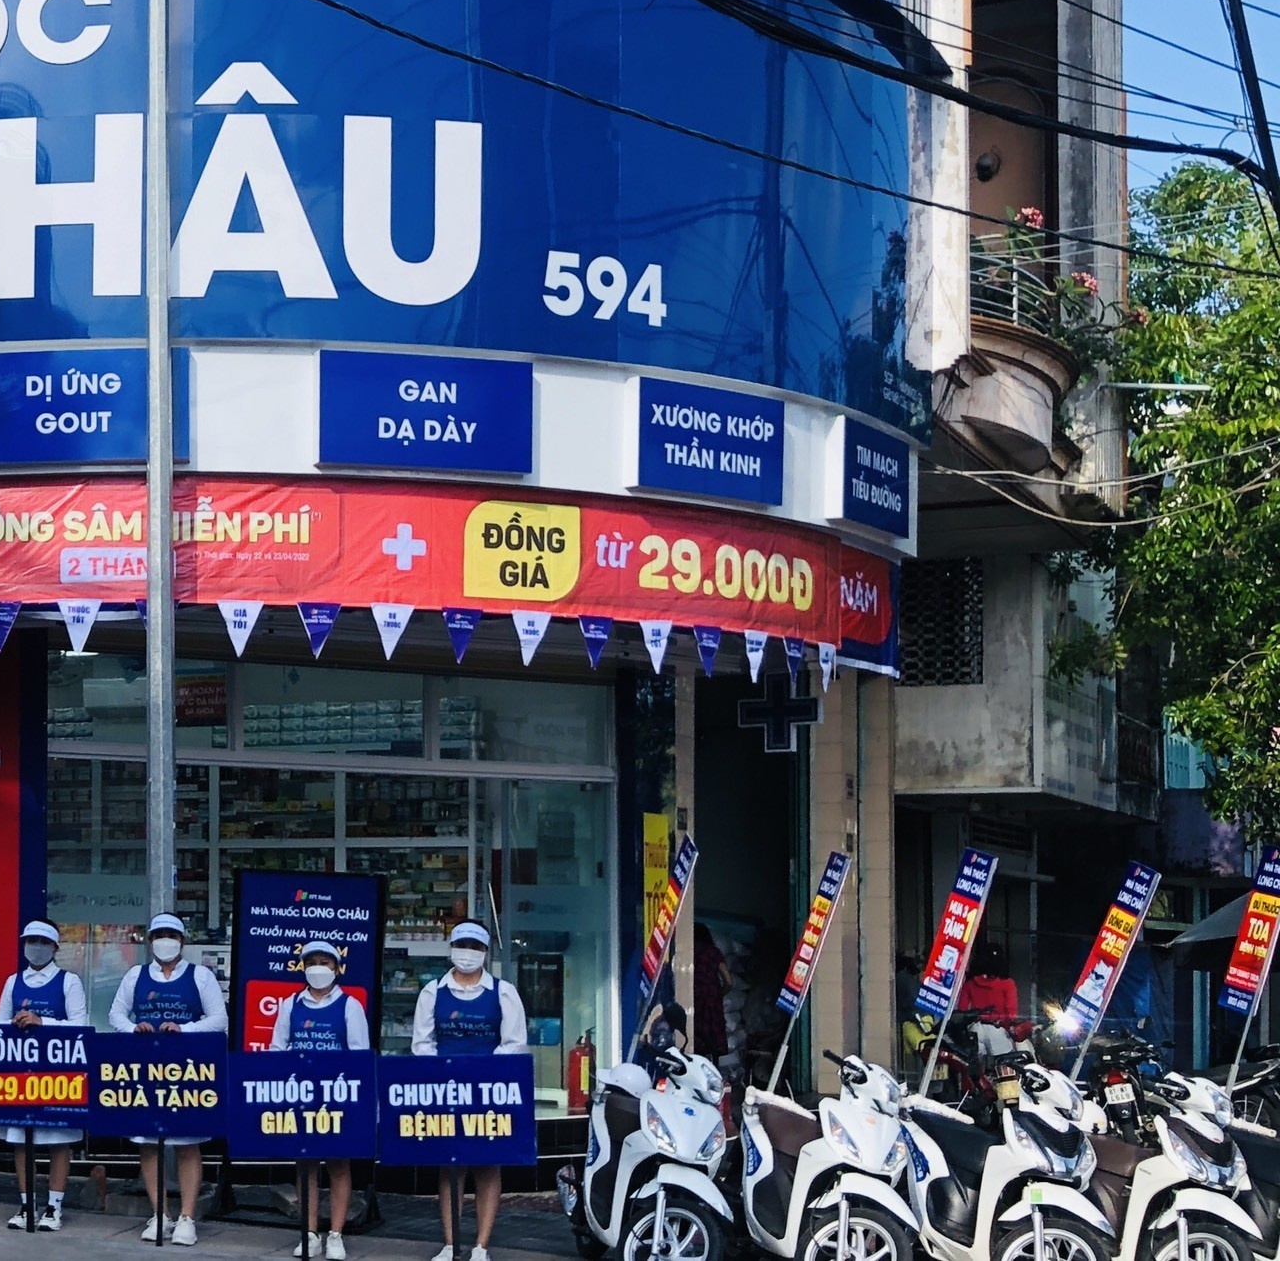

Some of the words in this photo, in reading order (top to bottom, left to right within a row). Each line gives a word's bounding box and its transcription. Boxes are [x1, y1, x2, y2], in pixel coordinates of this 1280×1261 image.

[542, 250, 668, 327] 594
[25, 375, 53, 402] DỊ
[60, 367, 122, 396] ỨNG
[398, 378, 458, 404] GAN
[35, 410, 112, 435] GOUT
[377, 416, 416, 446] DẠ
[424, 413, 477, 445] DÀY
[651, 402, 722, 434] XƯƠNG
[726, 413, 775, 443] KHỚP
[664, 436, 715, 470] THẦN
[719, 450, 761, 478] KINH
[856, 443, 871, 468] TIM
[872, 449, 899, 480] MẠCH
[851, 468, 870, 502] TIỂU
[870, 474, 902, 513] ĐƯỜNG
[63, 502, 143, 542] SÂM
[249, 504, 311, 544] PHÍ
[482, 512, 566, 554] ĐỒNG
[67, 557, 82, 577] 2
[87, 551, 148, 577] THÁN
[499, 554, 550, 589] GIÁ
[595, 531, 635, 570] từ
[638, 535, 814, 612] 29.000Đ
[840, 570, 879, 617] NĂM
[251, 905, 269, 915] NHÀ
[271, 905, 300, 917] THUỐC
[302, 907, 335, 919] LONG
[337, 907, 370, 921] CHÂU
[250, 925, 282, 937] CHUỖI
[284, 928, 307, 939] NHÀ
[308, 929, 345, 940] THUỐC
[346, 932, 368, 942] LỚN
[1247, 917, 1269, 942] TOA
[267, 945, 291, 954] HƠN
[269, 962, 284, 973] TẠI
[47, 1034, 88, 1064] GIÁ
[100, 1063, 141, 1087] BẠT
[148, 1058, 216, 1082] NGÀN
[243, 1073, 315, 1103] THUỐC
[320, 1072, 362, 1103] TỐT
[99, 1084, 151, 1108] QUÀ
[155, 1084, 219, 1113] TẶNG
[389, 1079, 472, 1107] CHUYÊN
[478, 1082, 522, 1105] TOA
[260, 1106, 297, 1134] GIÁ
[303, 1103, 344, 1134] TỐT
[399, 1111, 456, 1141] BỆNH
[461, 1110, 512, 1141] VIỆN
